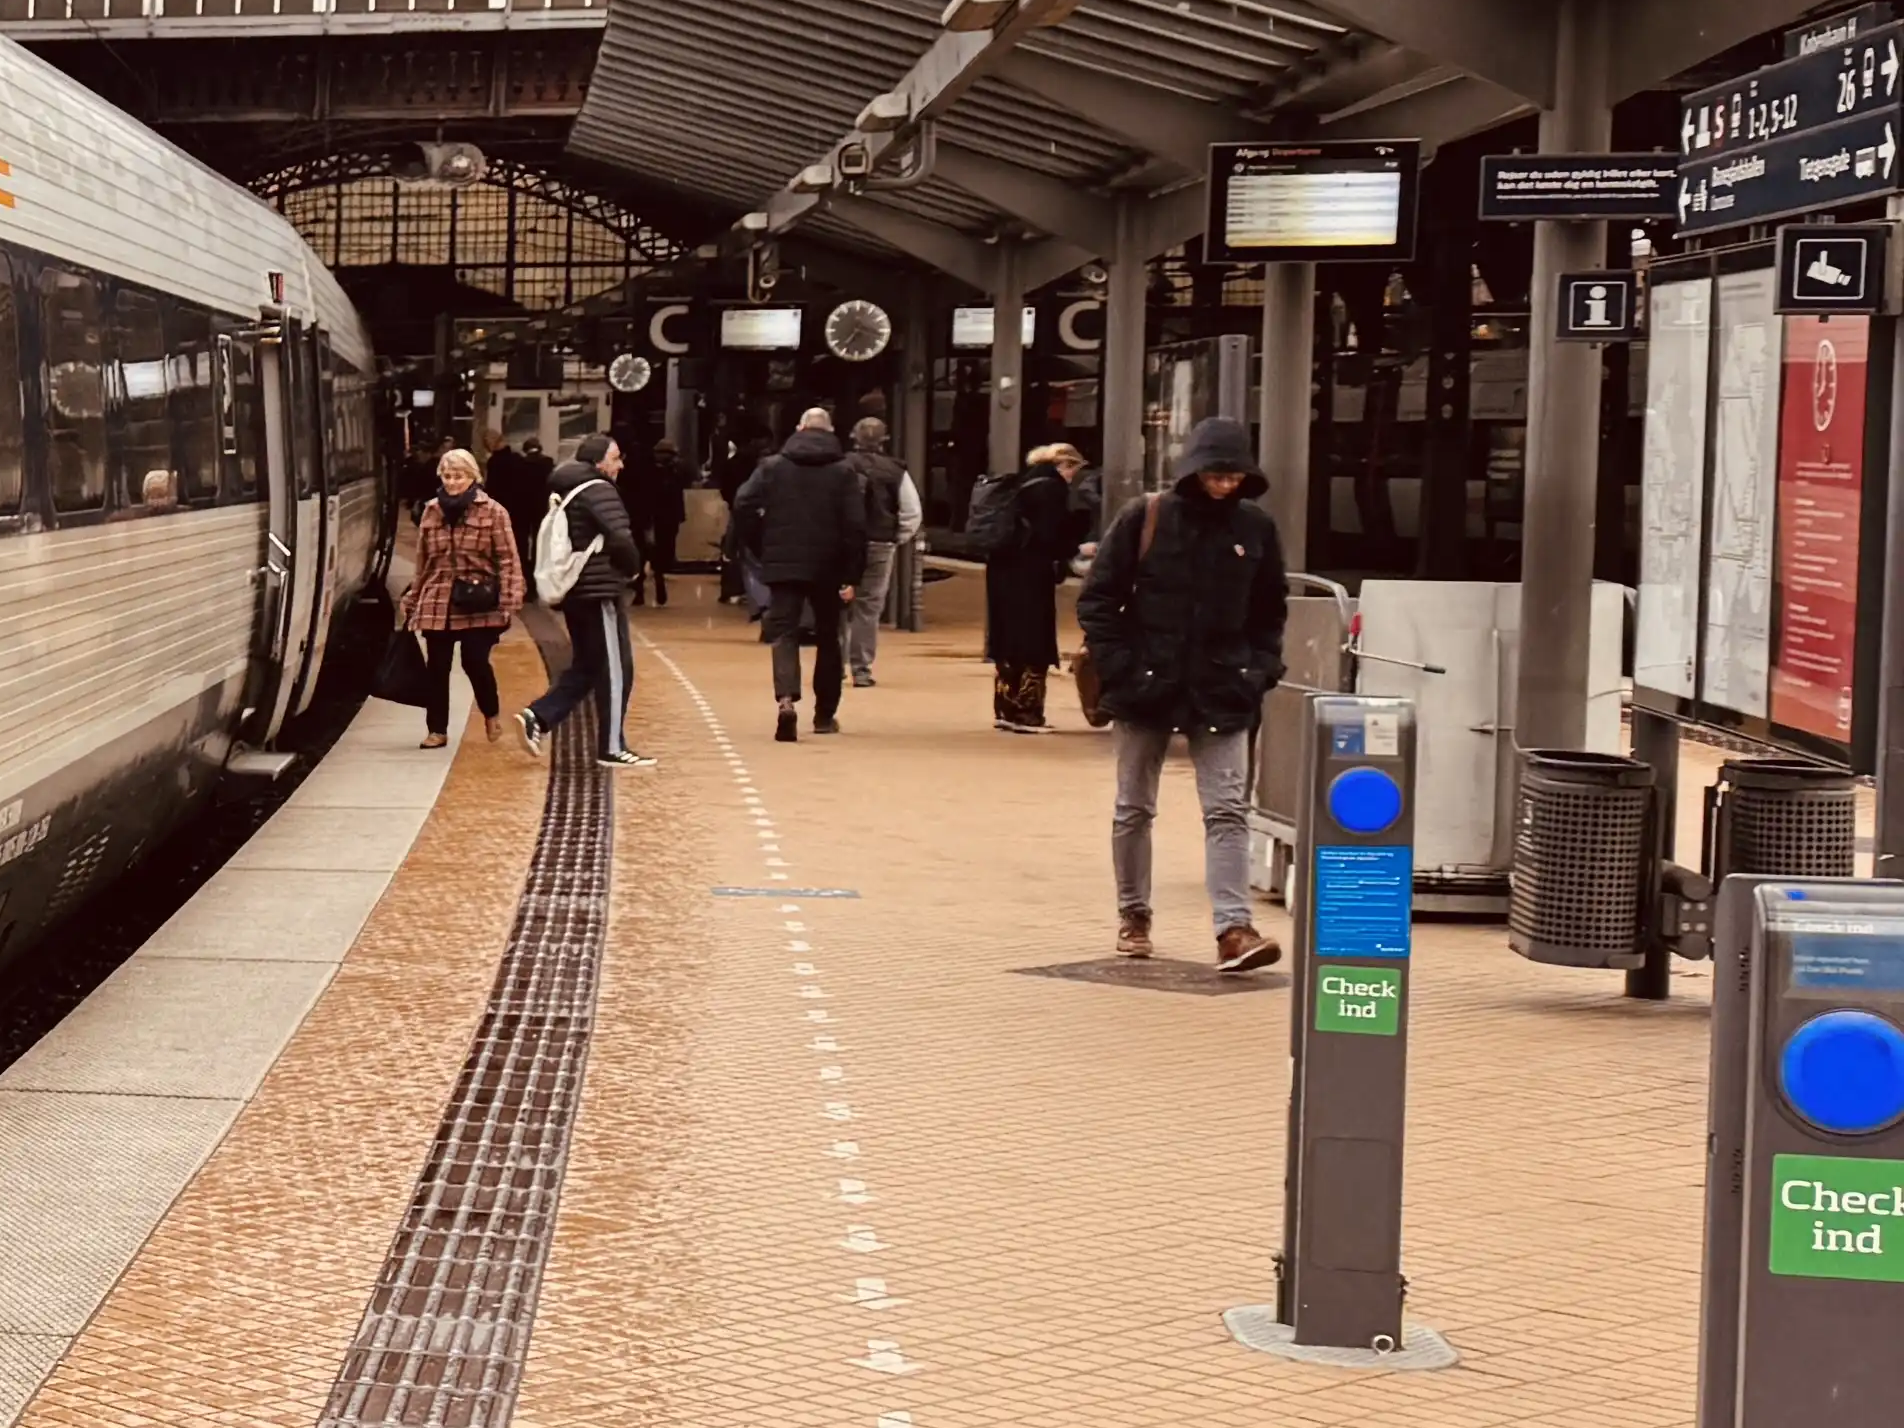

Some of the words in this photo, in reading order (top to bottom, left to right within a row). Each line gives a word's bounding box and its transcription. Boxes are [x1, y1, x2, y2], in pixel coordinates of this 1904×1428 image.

[1837, 69, 1856, 113] 26
[649, 304, 689, 354] C
[1059, 300, 1102, 350] C
[1322, 976, 1396, 998] Check
[1338, 999, 1377, 1018] ind
[1811, 1220, 1883, 1254] ind
